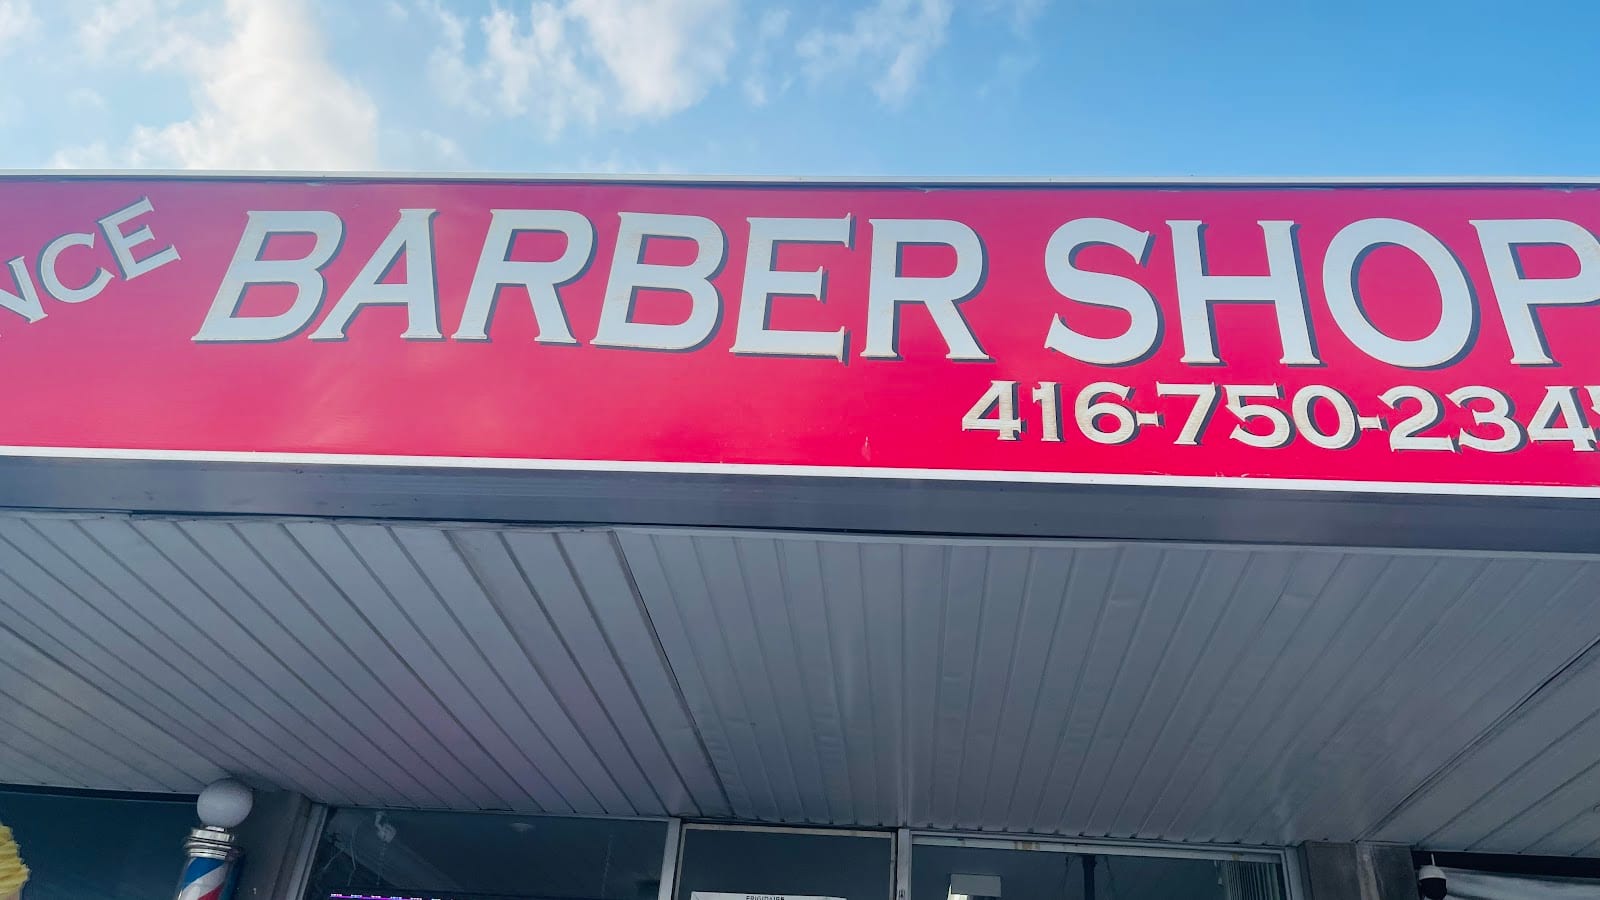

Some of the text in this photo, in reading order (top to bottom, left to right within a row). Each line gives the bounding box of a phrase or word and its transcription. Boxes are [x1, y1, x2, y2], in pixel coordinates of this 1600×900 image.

[191, 208, 1600, 368] BARBER SHOP
[961, 380, 1600, 454] 416-750-234
